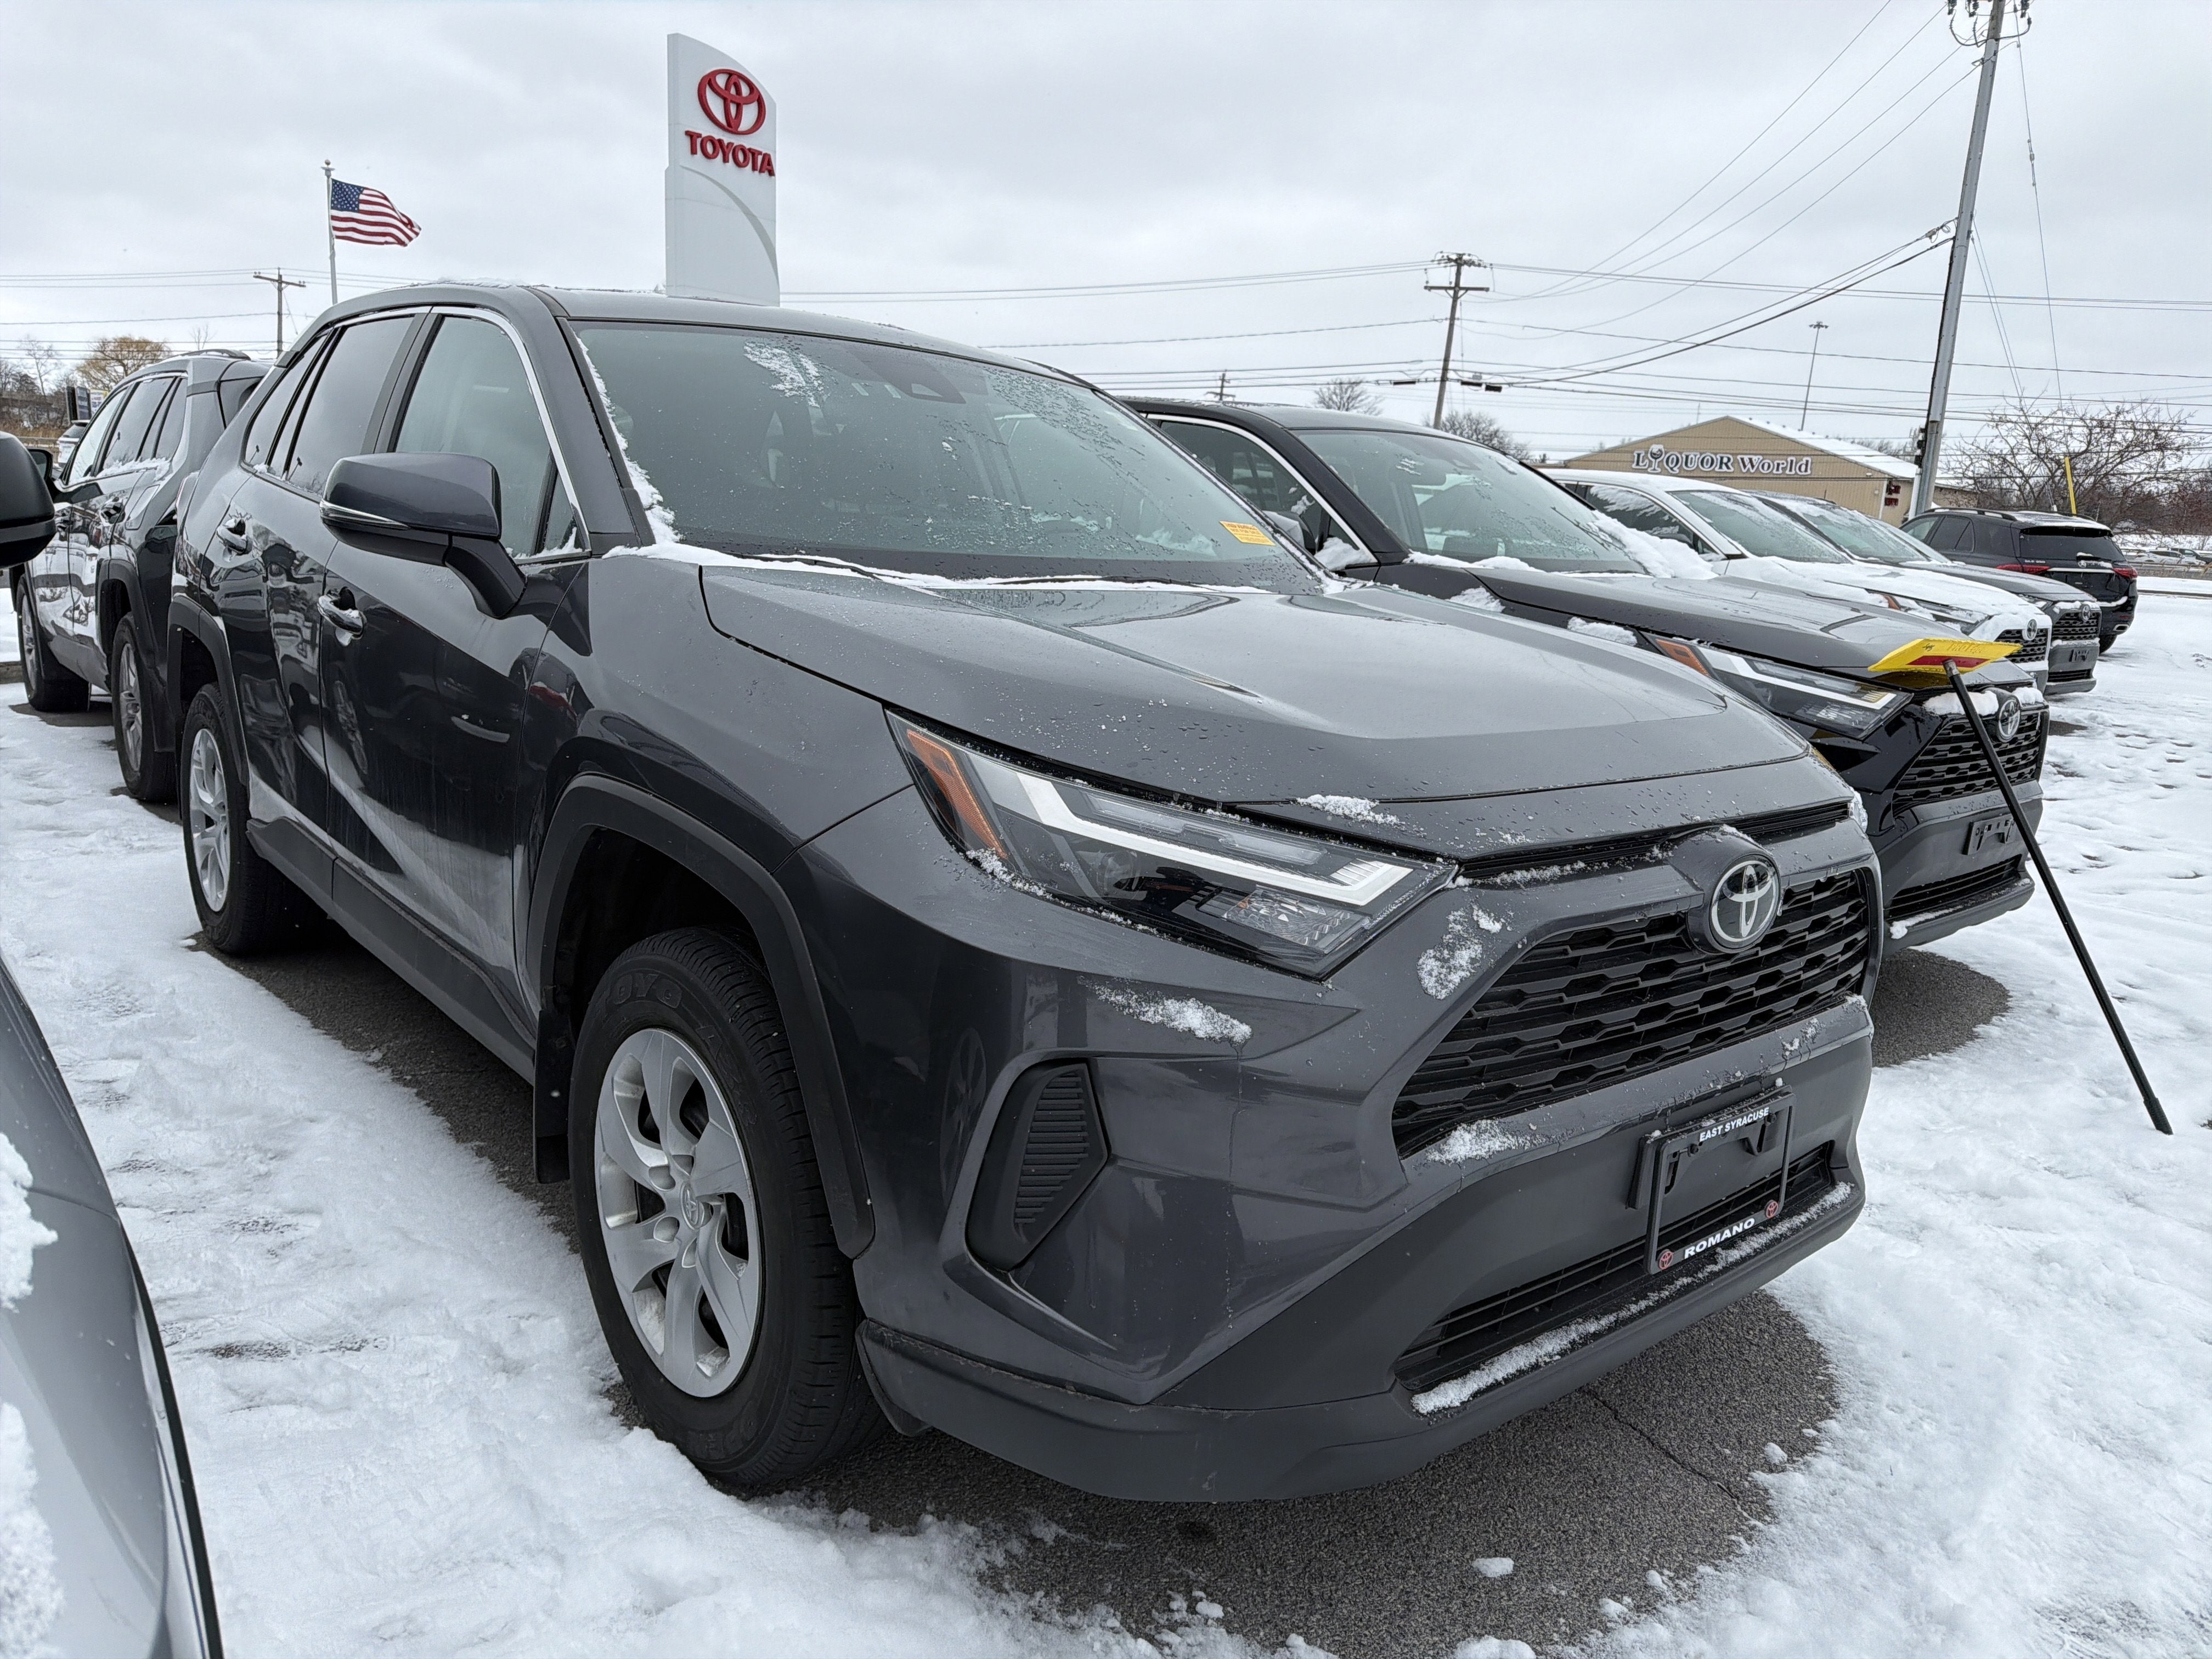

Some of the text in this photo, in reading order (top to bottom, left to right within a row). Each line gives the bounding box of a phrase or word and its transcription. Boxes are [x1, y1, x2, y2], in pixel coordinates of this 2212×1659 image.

[685, 130, 775, 177] TOYOTA
[1737, 454, 1811, 475] World
[1699, 1107, 1769, 1142] EAST SYRACUSE
[1684, 1218, 1755, 1259] ROMANO
